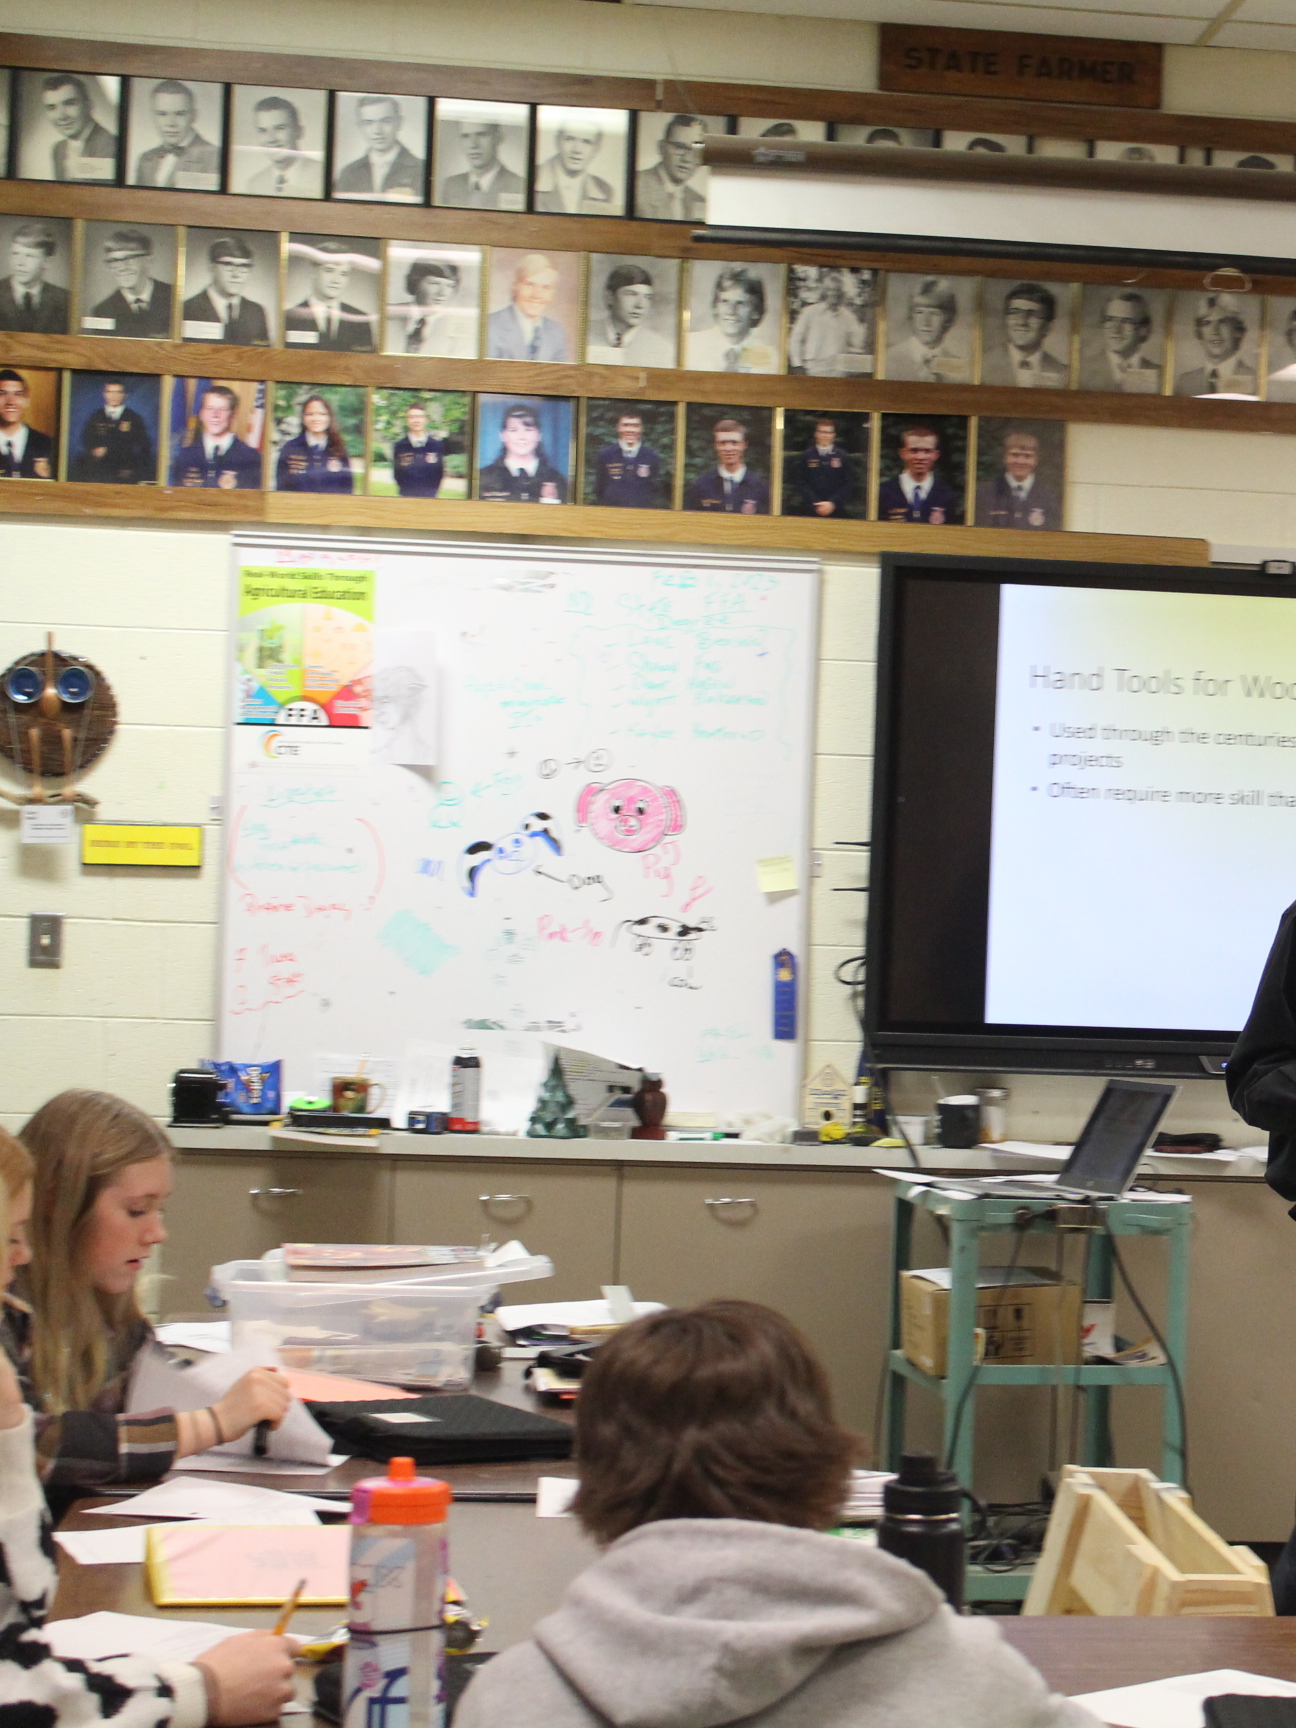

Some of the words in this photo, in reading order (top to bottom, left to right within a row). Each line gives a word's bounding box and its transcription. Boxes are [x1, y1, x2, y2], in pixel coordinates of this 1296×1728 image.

[904, 47, 999, 76] STATE
[1016, 53, 1137, 84] FARMER
[243, 583, 308, 600] Agricultural
[311, 586, 367, 601] Education
[1029, 664, 1104, 692] Hand
[1112, 668, 1185, 696] Tools
[1192, 670, 1233, 697] for
[286, 707, 322, 723] FFA
[1049, 722, 1096, 740] Used
[1101, 724, 1174, 745] through
[1178, 728, 1210, 745] the
[1048, 750, 1124, 770] projects
[1047, 781, 1100, 799] Often
[1103, 784, 1171, 807] require
[1176, 790, 1226, 804] more
[1228, 788, 1265, 806] skill
